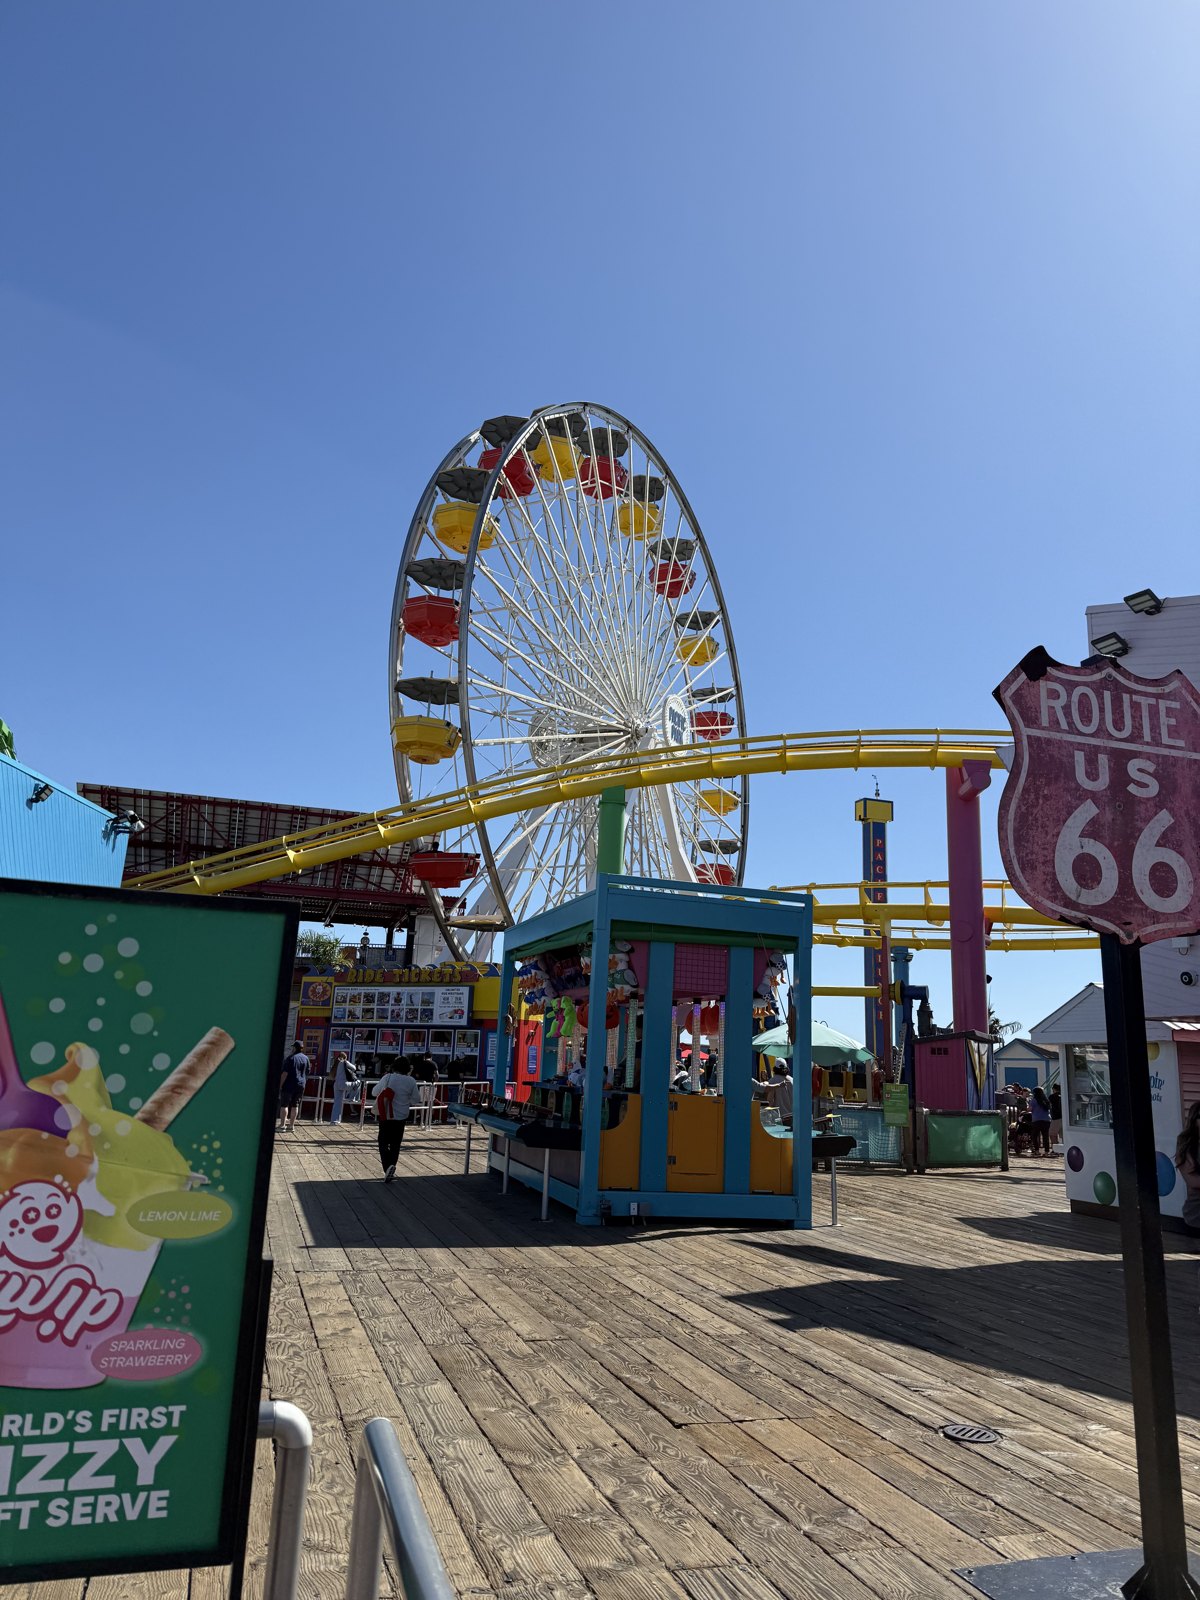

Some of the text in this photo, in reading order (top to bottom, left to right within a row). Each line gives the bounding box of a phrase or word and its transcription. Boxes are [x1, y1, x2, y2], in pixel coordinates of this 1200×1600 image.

[1039, 680, 1185, 747] ROUTE
[1054, 798, 1194, 914] 66
[347, 967, 462, 984] RIDE TICKETS
[138, 1209, 222, 1223] LEMON LIME
[0, 1264, 124, 1347] wip
[99, 1352, 192, 1370] STRAWBERRY
[109, 1337, 186, 1353] SPARKLING
[1, 1404, 187, 1437] RLD'S FIRST
[45, 1489, 170, 1528] SERVE
